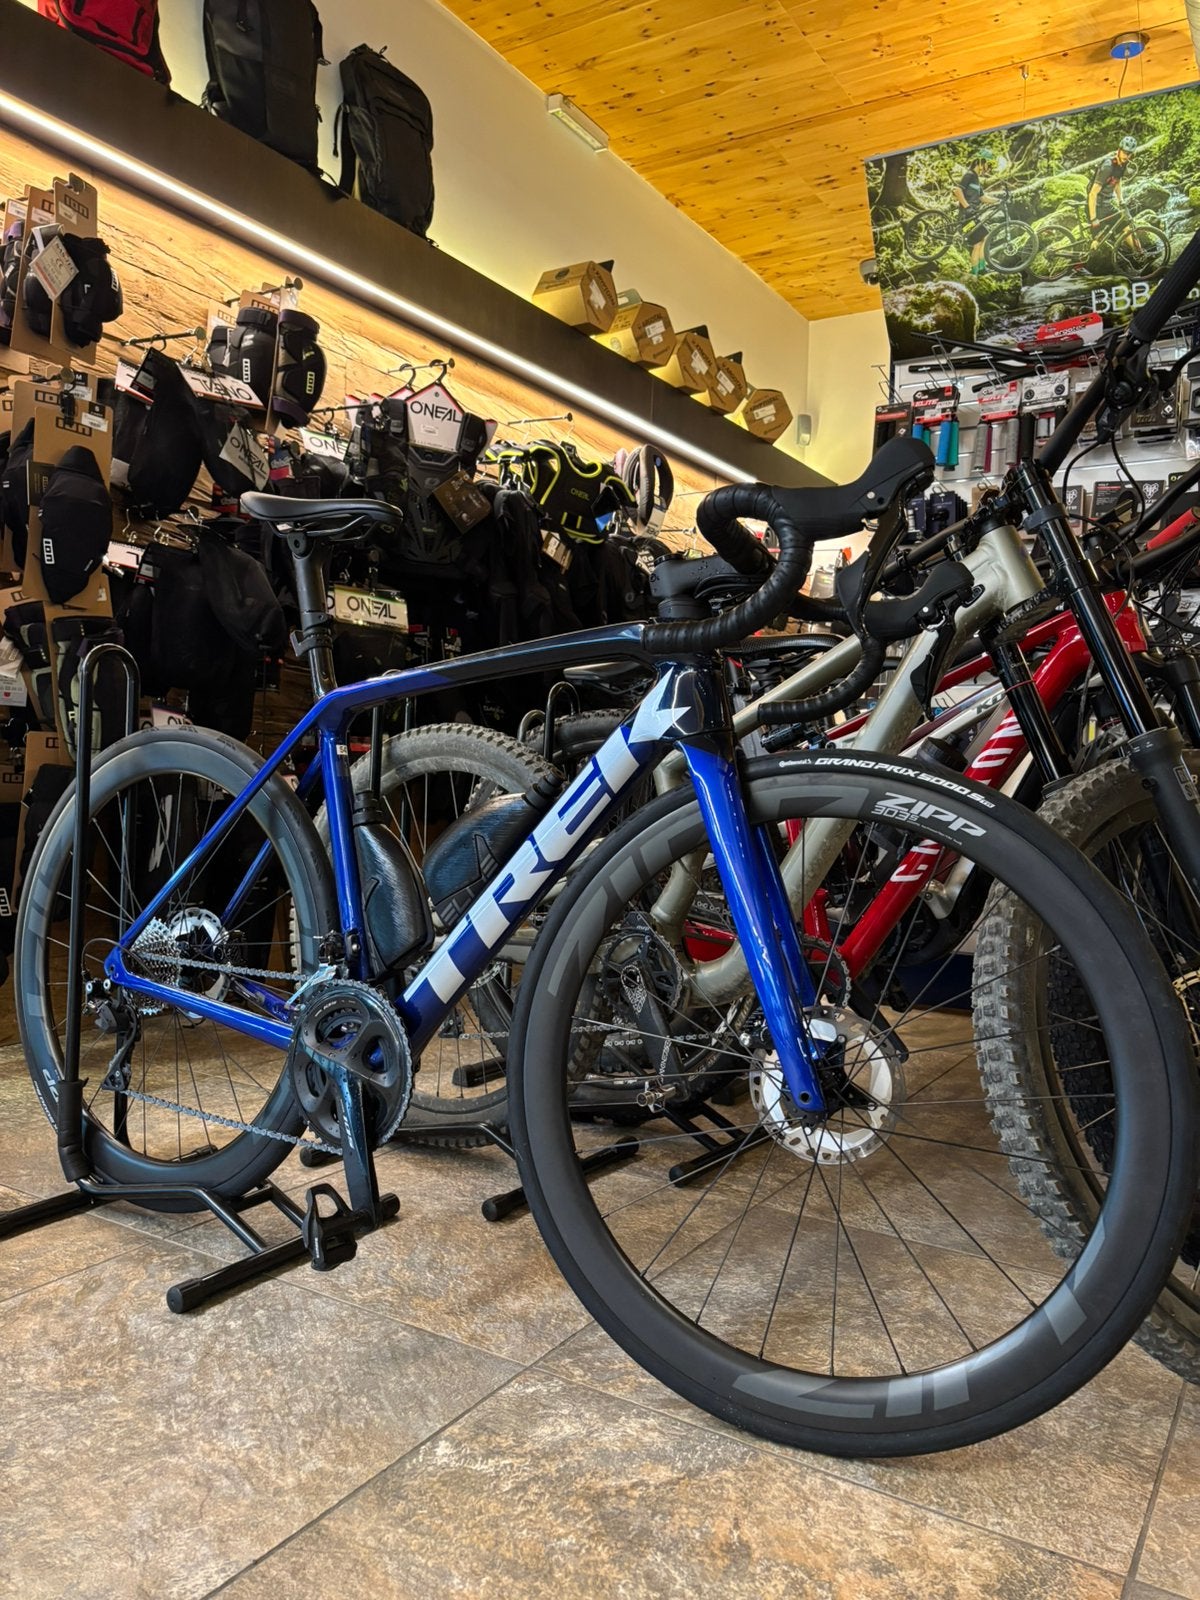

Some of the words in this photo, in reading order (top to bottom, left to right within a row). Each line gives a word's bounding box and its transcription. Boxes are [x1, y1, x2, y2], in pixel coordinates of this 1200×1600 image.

[814, 757, 877, 770] GRAND
[872, 762, 921, 779] PRIX
[402, 665, 692, 1005] TREK
[875, 791, 988, 838] ZIPP
